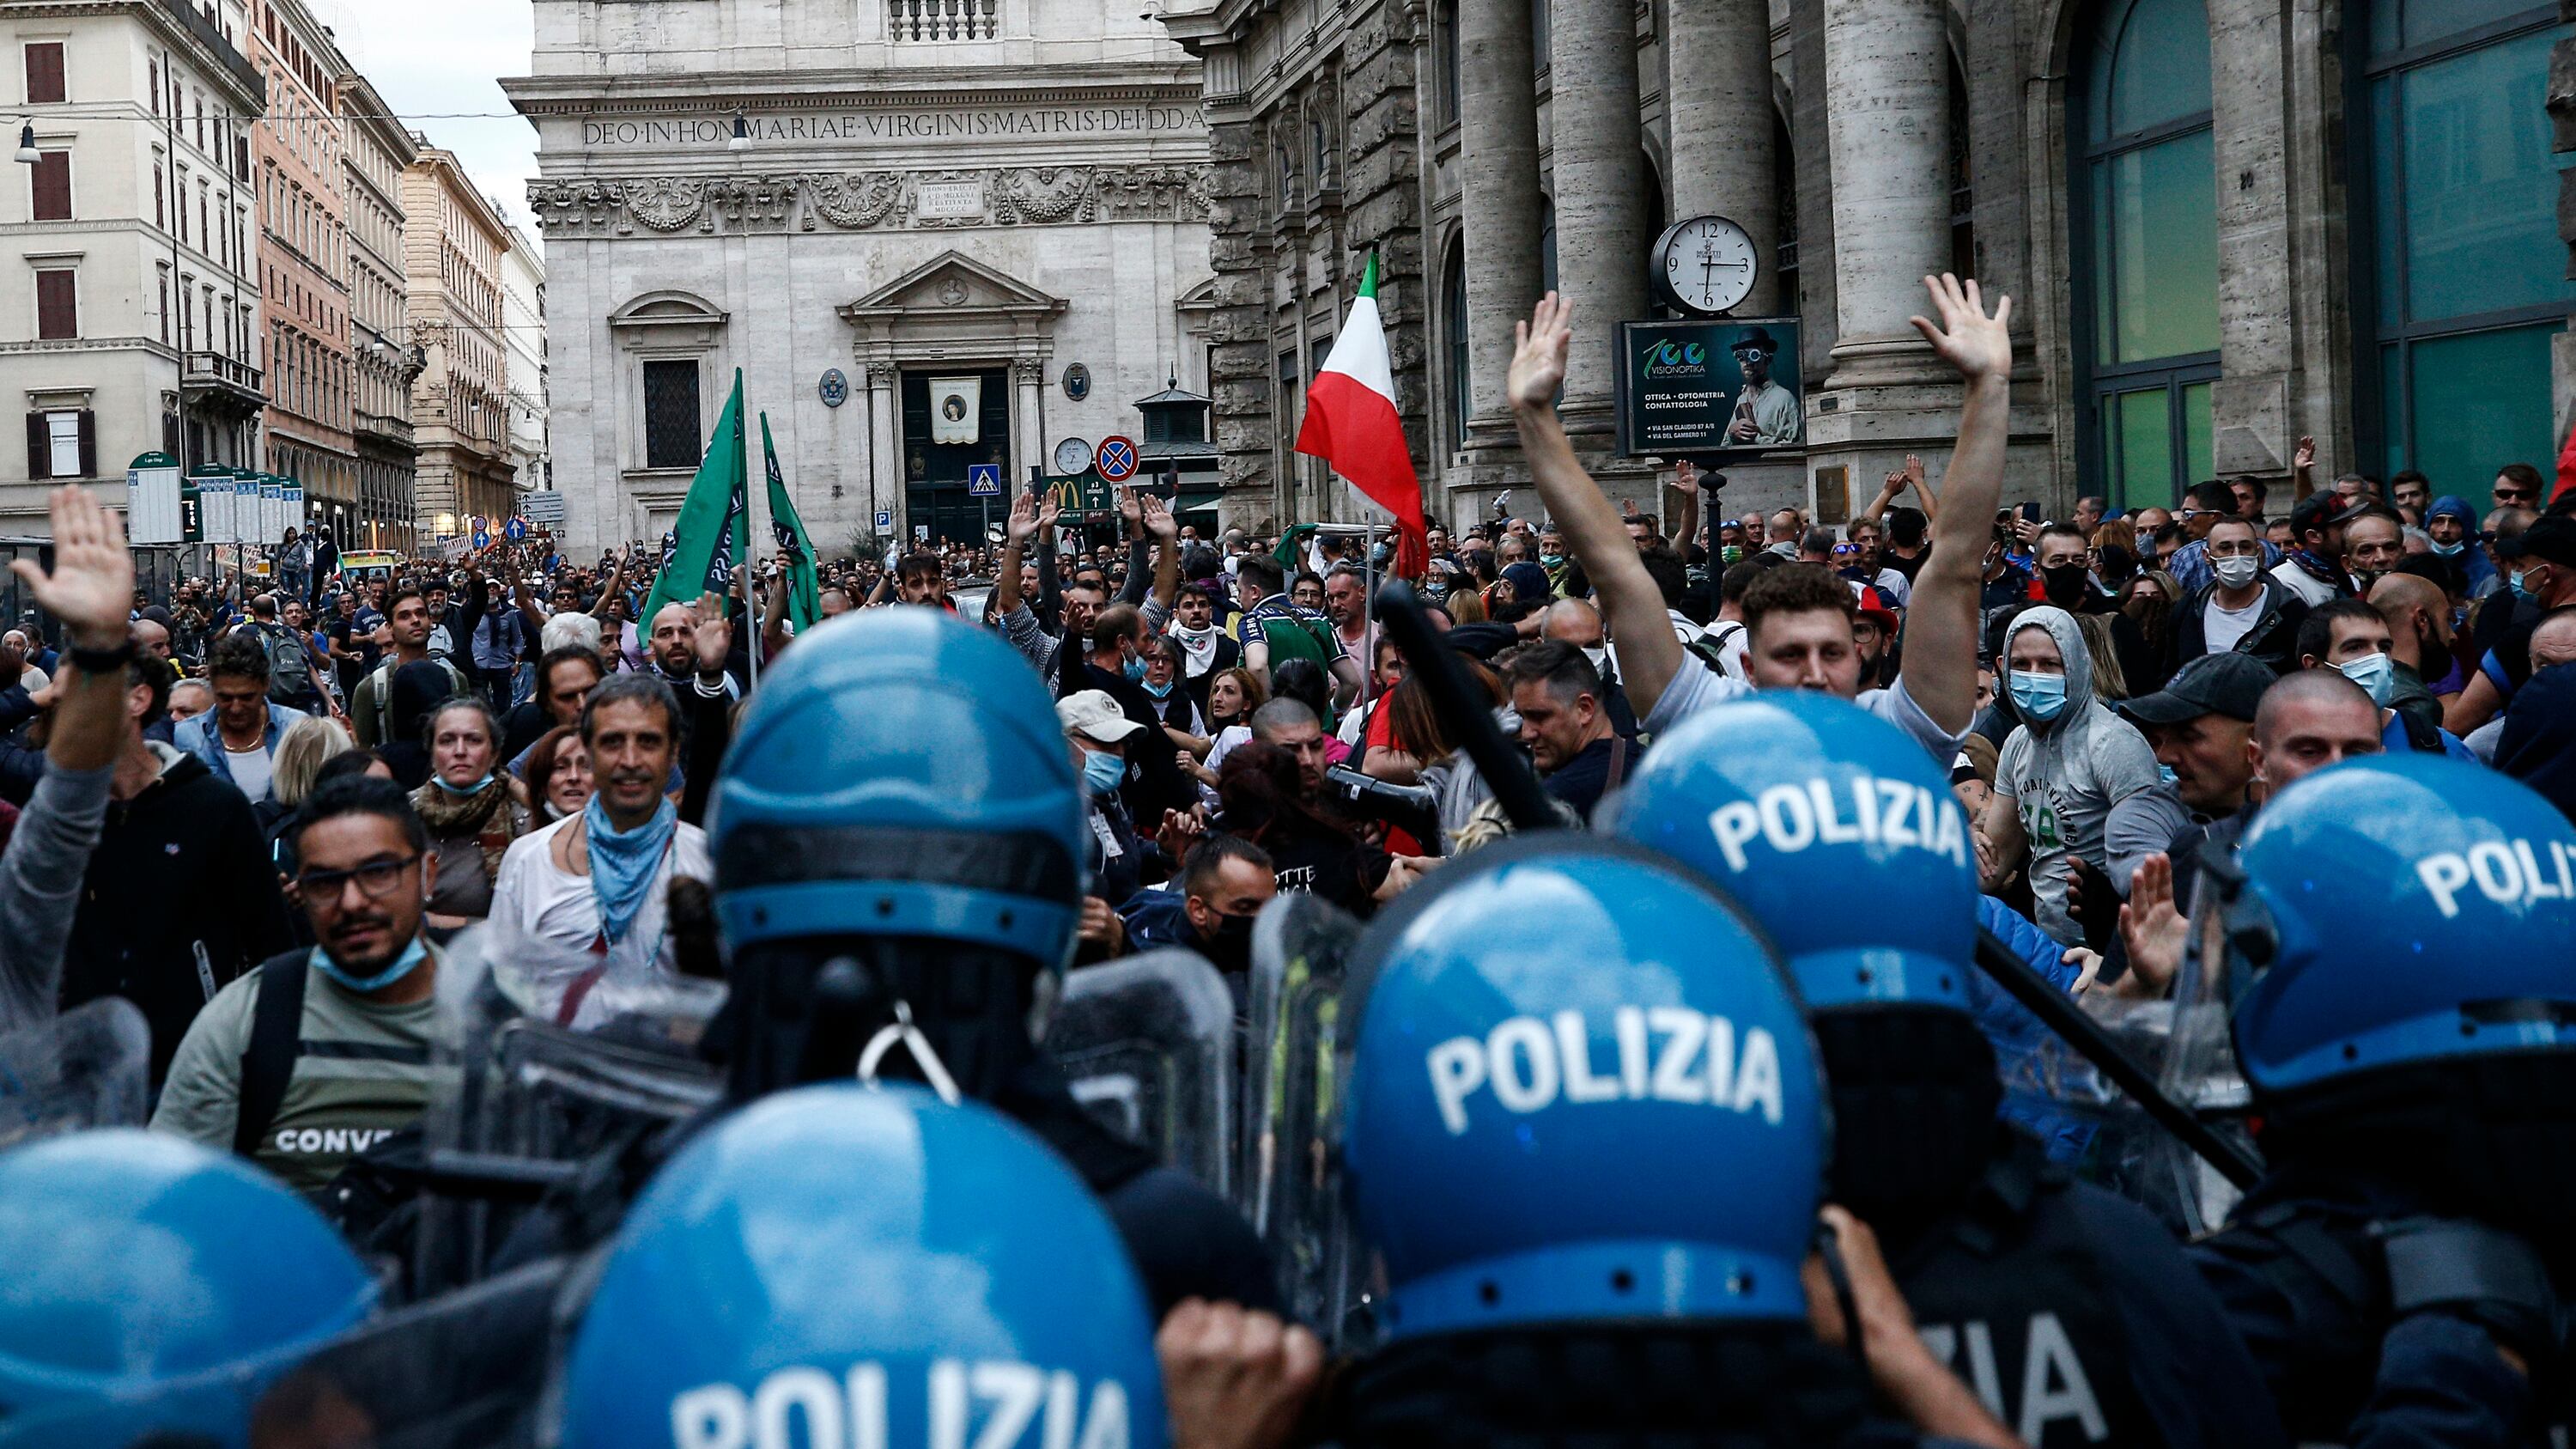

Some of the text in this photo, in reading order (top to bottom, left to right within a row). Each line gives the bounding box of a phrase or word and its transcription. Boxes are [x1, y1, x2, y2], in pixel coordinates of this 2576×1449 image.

[584, 119, 638, 145] DEO
[644, 120, 672, 143] IN
[744, 116, 857, 140] MARIAE
[866, 112, 988, 137] VIRGINIS
[993, 110, 1096, 135] MATRIS
[1100, 108, 1141, 131] DEI
[1701, 222, 1718, 238] 12
[1668, 257, 1678, 272] 9
[1740, 258, 1748, 272] 3
[1704, 291, 1713, 307] 6
[1651, 365, 1705, 374] VISIONOPTIKA
[1645, 401, 1708, 410] CONTATTOLOGIA
[878, 514, 886, 524] P
[1708, 776, 1966, 874] POLIZIA
[2415, 837, 2576, 919] POLI
[1425, 1005, 1784, 1136] POLIZIA
